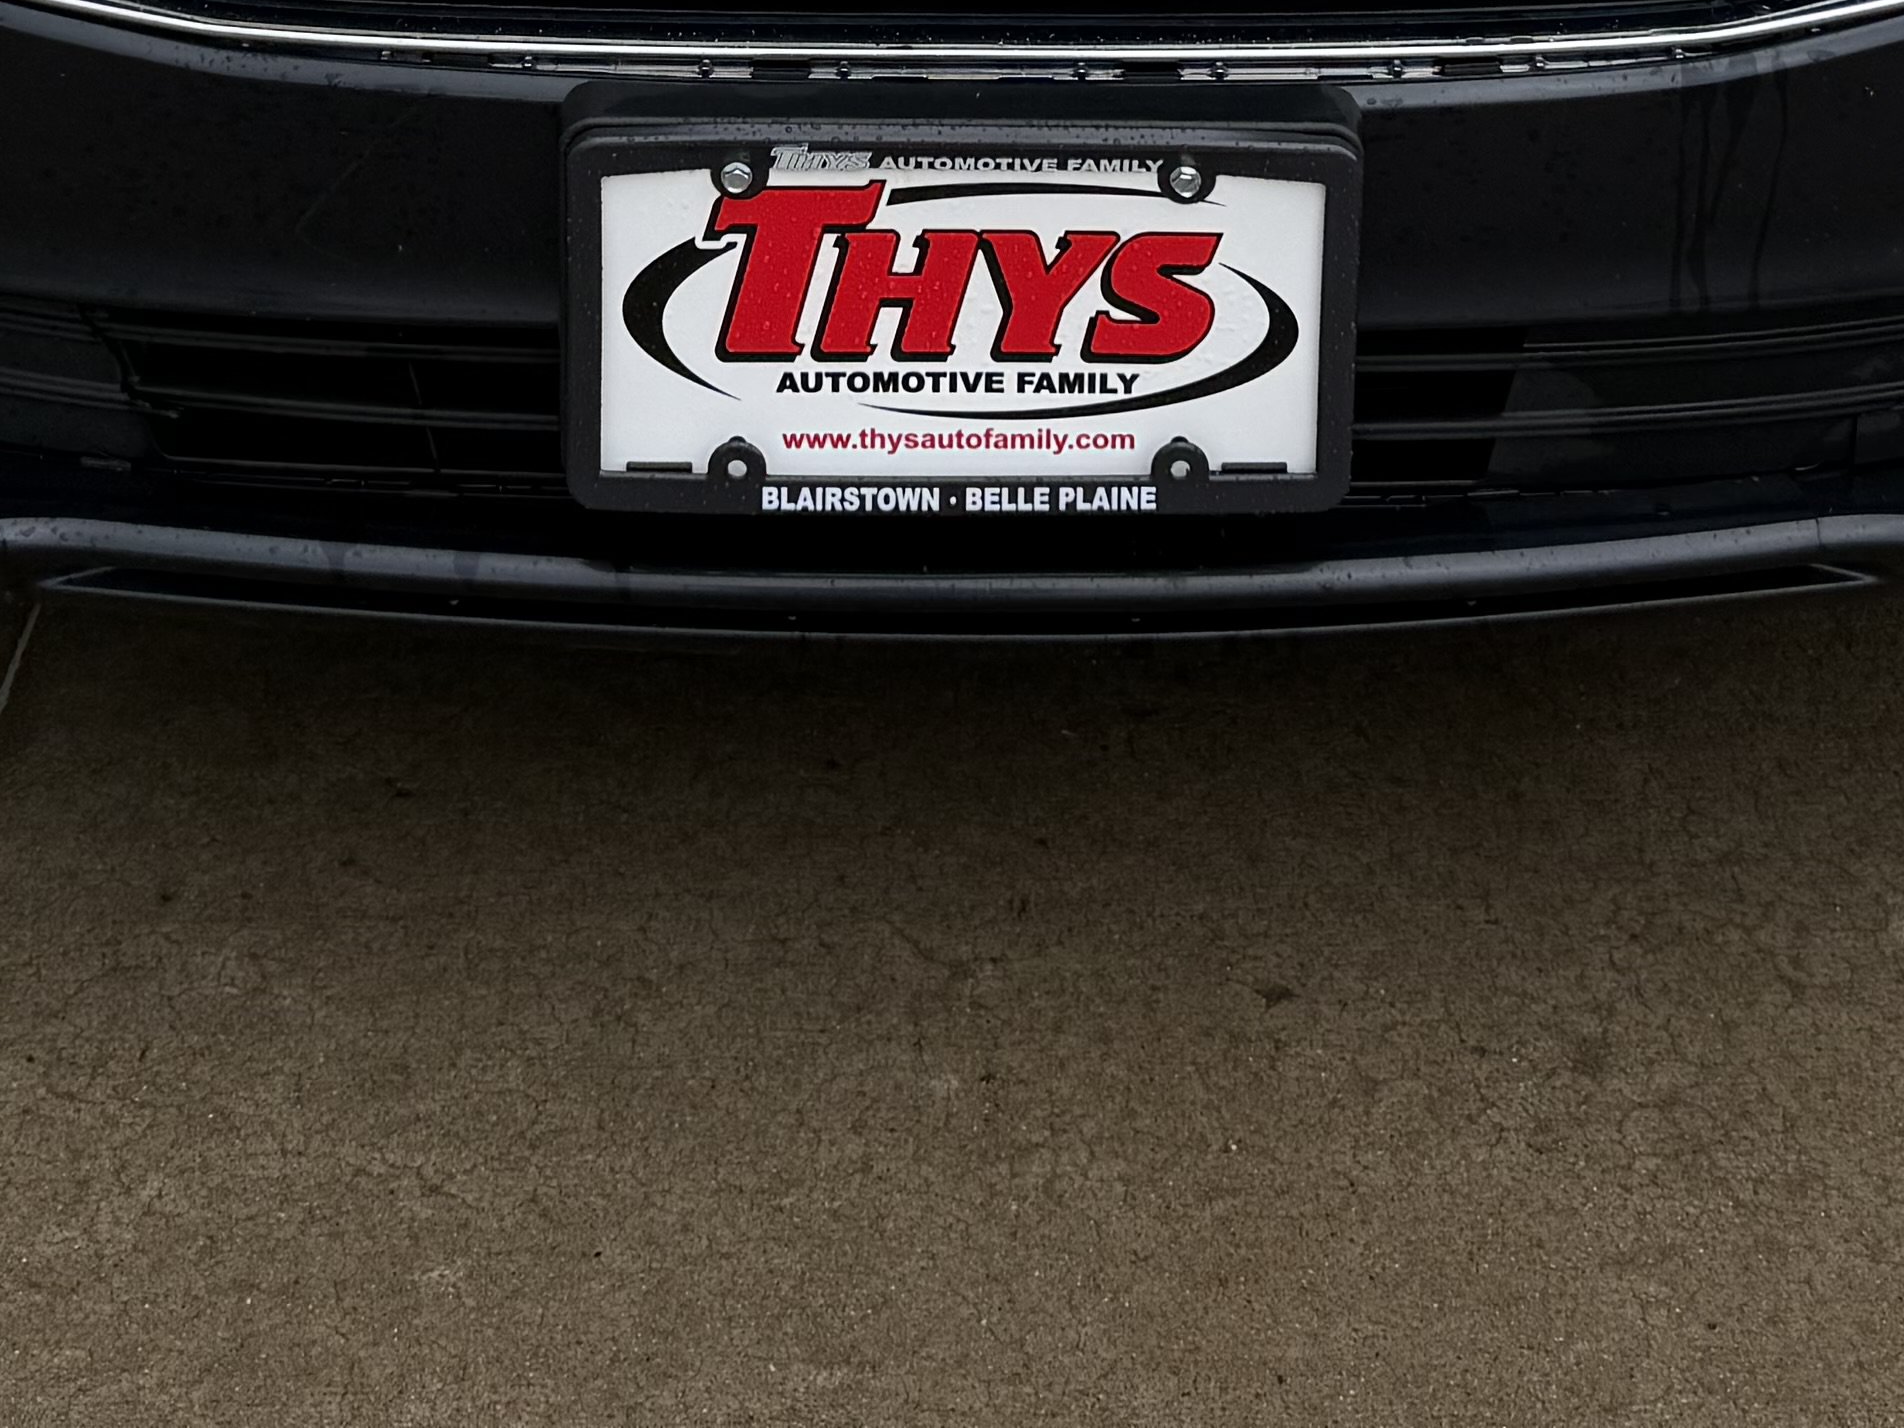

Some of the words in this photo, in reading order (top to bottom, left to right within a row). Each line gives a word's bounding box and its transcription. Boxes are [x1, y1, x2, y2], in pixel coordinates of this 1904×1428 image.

[880, 157, 1058, 172] AUTOMOTIVE
[1066, 157, 1164, 173] FAMILY
[708, 178, 1224, 363] THYS
[776, 371, 1005, 395] AUTOMOTIVE
[1015, 371, 1140, 395] FAMILY
[782, 427, 1136, 455] www.thysautofamily.com
[761, 485, 941, 512] BLAIRSTOWN
[966, 486, 1053, 512] BELLE
[1058, 485, 1157, 511] PLAINE
